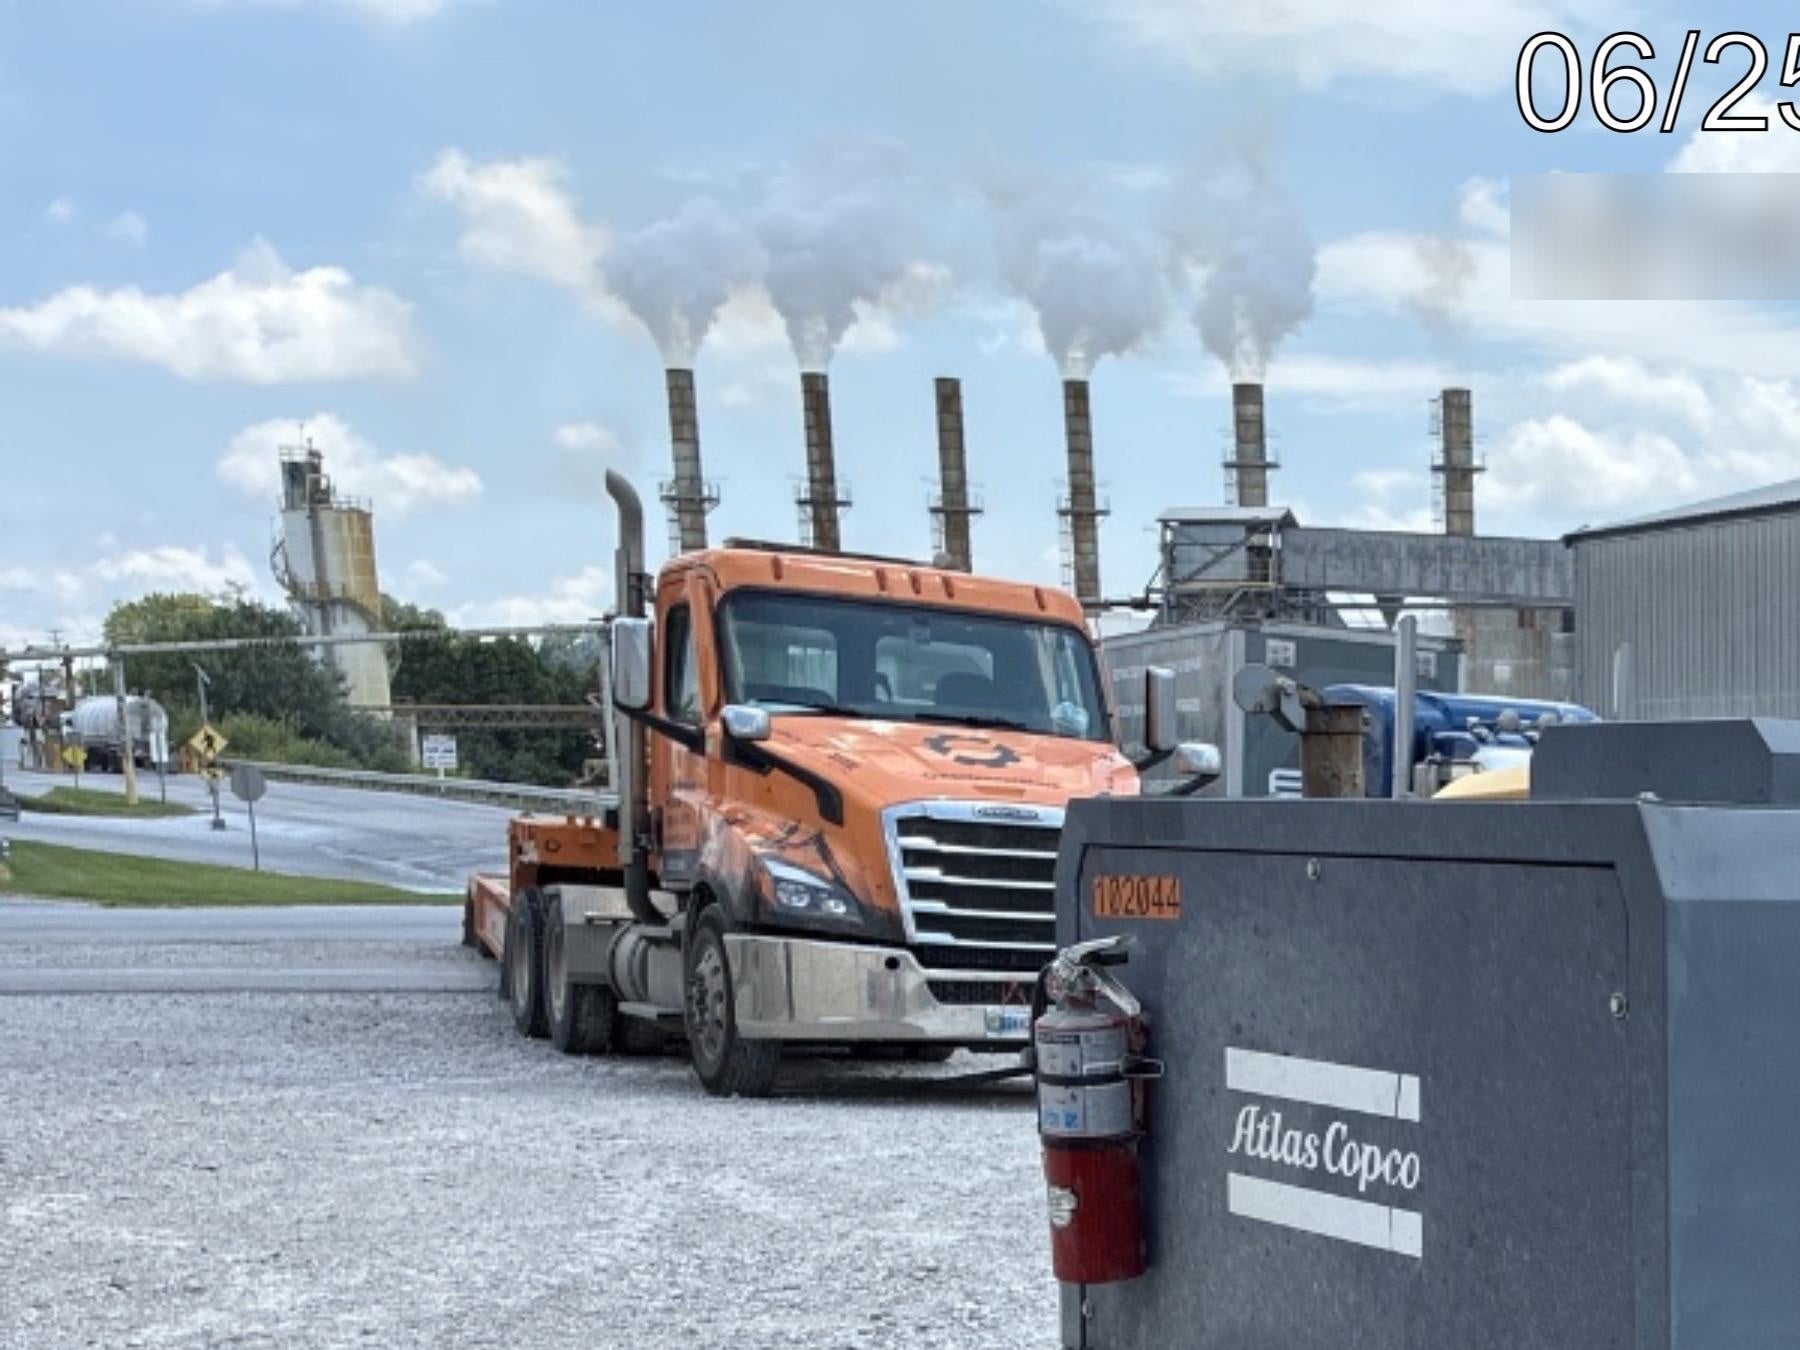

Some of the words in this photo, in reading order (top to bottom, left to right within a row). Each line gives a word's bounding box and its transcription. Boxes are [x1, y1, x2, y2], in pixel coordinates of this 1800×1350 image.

[1095, 876, 1180, 916] 102044
[1226, 1104, 1320, 1171] Atlas
[1322, 1120, 1421, 1193] Copco
